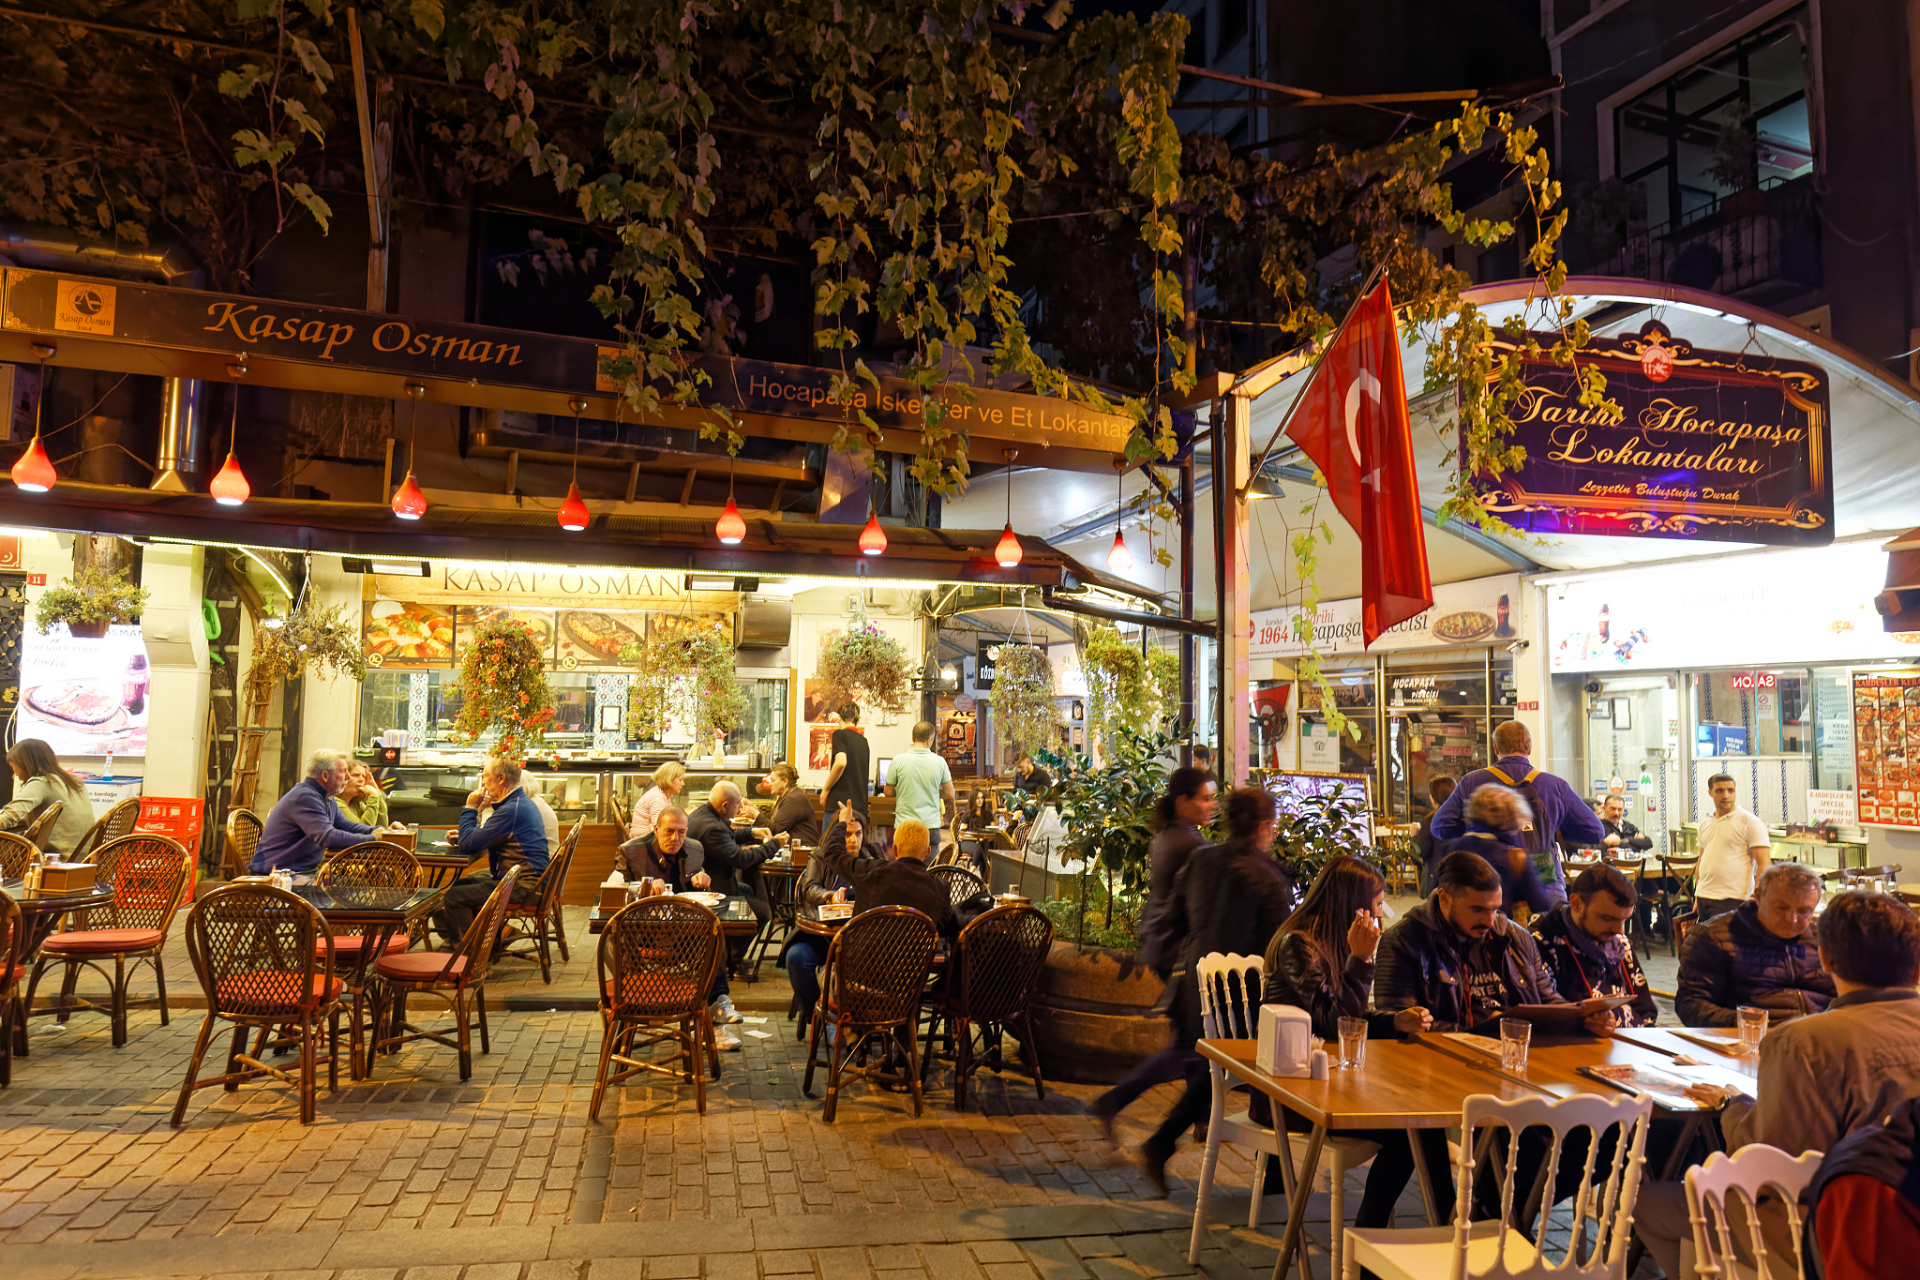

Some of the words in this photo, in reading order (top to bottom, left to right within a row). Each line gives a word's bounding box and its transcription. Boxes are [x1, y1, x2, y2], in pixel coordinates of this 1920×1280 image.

[59, 312, 83, 326] Kasap
[85, 315, 111, 326] Osman
[203, 302, 355, 360] Kasap
[372, 322, 523, 366] Osman
[978, 407, 1004, 424] ve
[1011, 406, 1033, 428] Et
[1638, 398, 1808, 450] Hocapaşa
[1547, 424, 1765, 475] Lokantaları
[1579, 480, 1631, 496] Lezzetin
[1635, 483, 1698, 501] Buluştuğu
[1701, 487, 1741, 501] Durak
[32, 576, 41, 584] 11
[443, 566, 546, 593] KASAP
[559, 572, 681, 596] OSMAN
[1260, 625, 1288, 645] 1964
